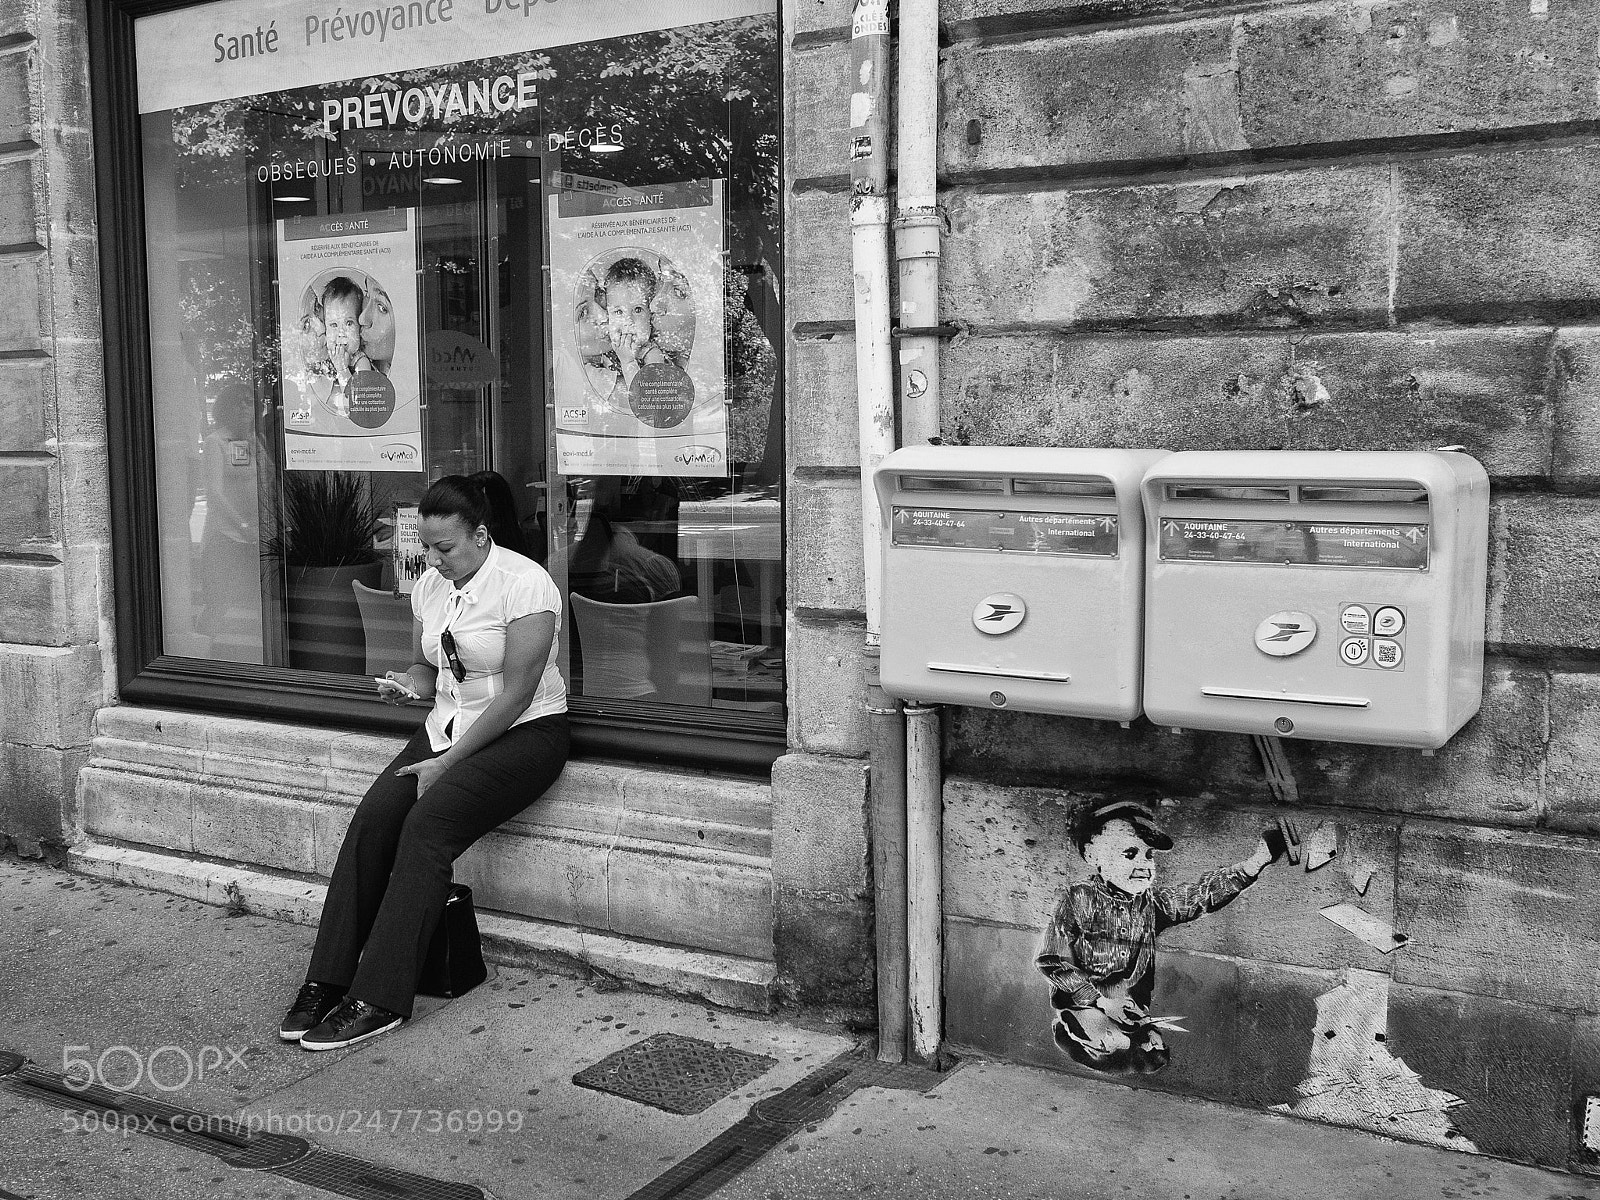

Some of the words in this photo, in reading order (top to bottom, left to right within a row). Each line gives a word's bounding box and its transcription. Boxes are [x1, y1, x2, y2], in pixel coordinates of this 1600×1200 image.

[213, 21, 279, 63] Santé
[305, 0, 453, 46] Prévoyance
[323, 71, 538, 132] PRÉVOYANCE
[257, 156, 357, 183] OBSÈQUES
[388, 139, 511, 171] AUTONOMIE
[548, 122, 624, 152] DÉCÈS
[602, 195, 632, 207] ACCÈS
[634, 192, 664, 205] SANTÉ
[320, 221, 344, 232] ACCÈS
[345, 218, 369, 231] SANTÉ
[290, 411, 310, 420] ACS-P
[563, 409, 587, 418] ACS-P
[913, 511, 950, 520] AQUITAINE
[1019, 515, 1043, 523] Autres
[1044, 515, 1096, 525] départements
[913, 519, 965, 528] 24-33-40-47-64
[1184, 522, 1228, 531] AQUITAINE
[1048, 528, 1095, 537] International
[1309, 525, 1338, 534] Autres
[1340, 526, 1400, 536] départements
[1184, 531, 1246, 541] 24-33-40-47-64
[1343, 540, 1400, 549] International
